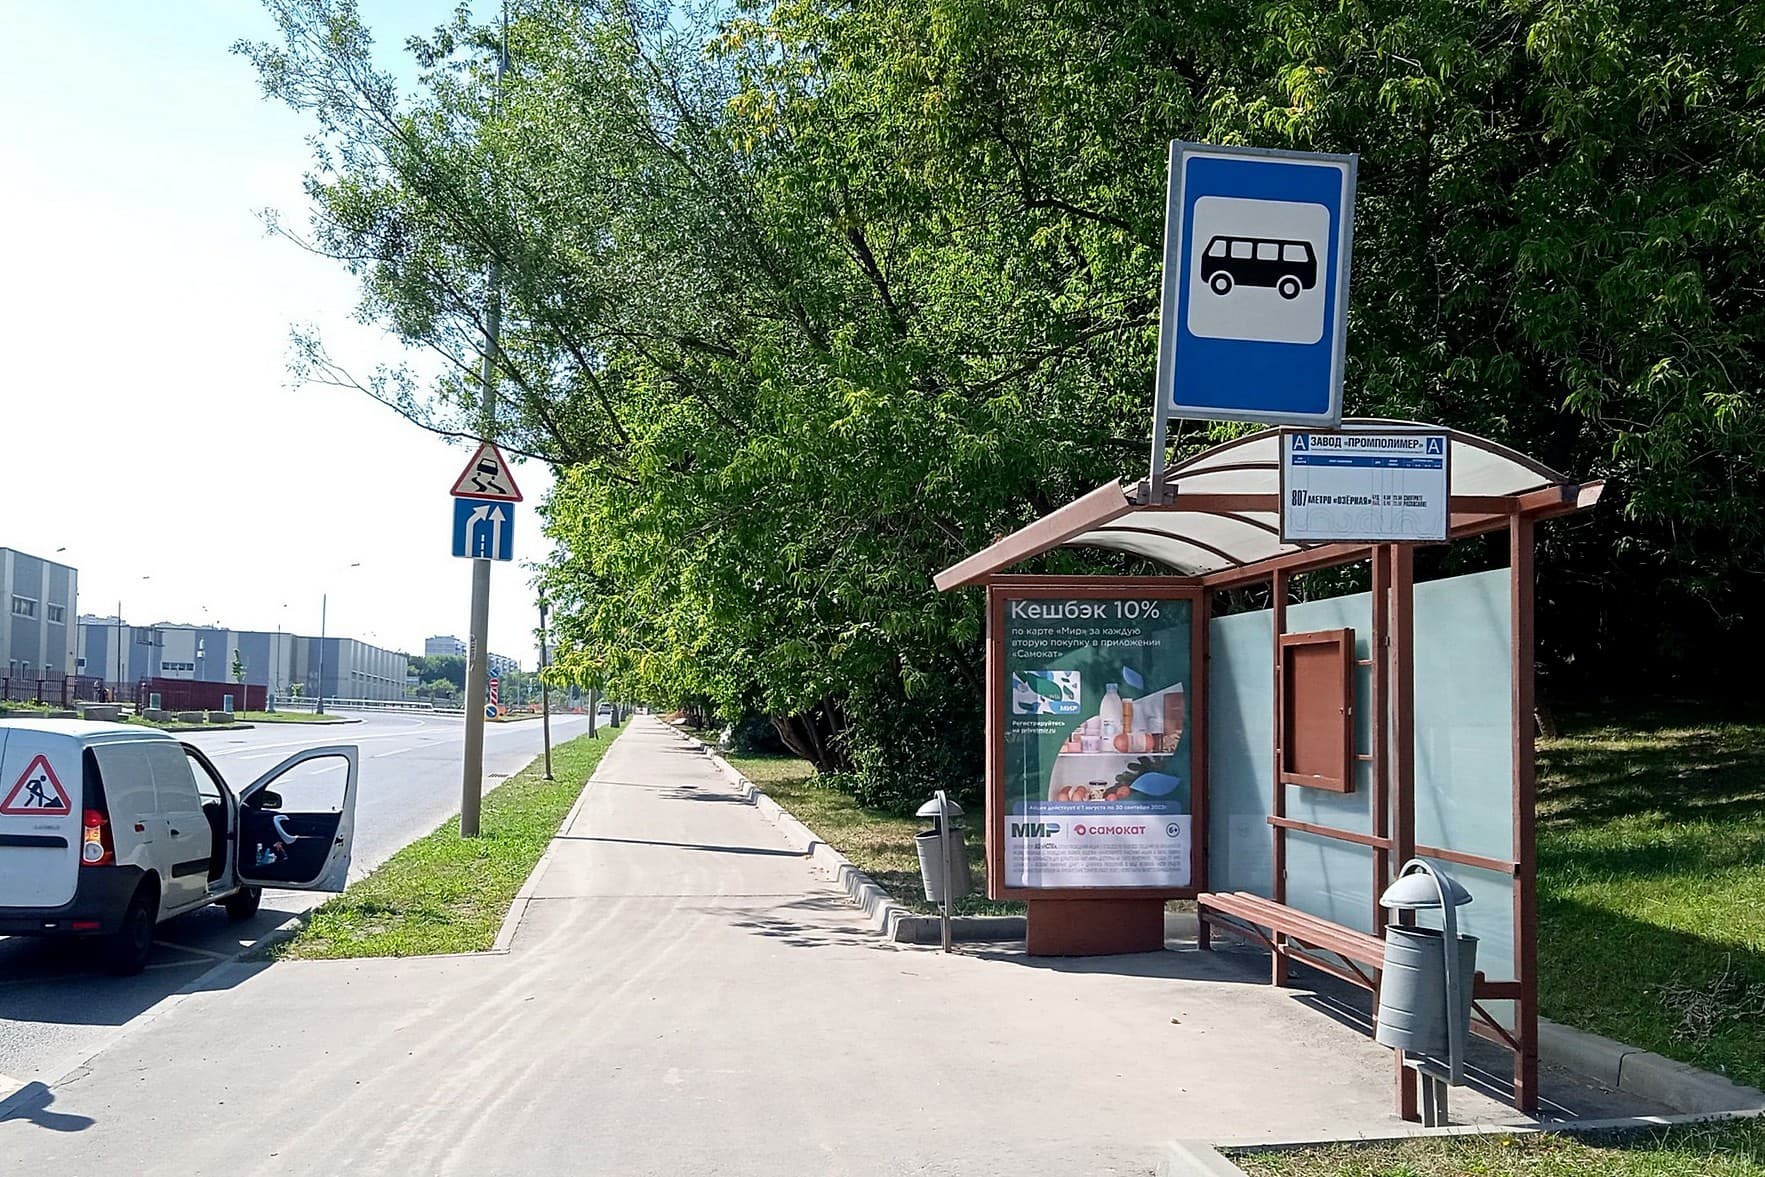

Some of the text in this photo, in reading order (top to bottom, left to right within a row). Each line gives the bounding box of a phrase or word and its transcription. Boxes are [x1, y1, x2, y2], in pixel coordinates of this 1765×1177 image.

[1310, 436, 1342, 448] ЗАВОД
[1343, 437, 1424, 449] «ПРОМПОЛИМЕР»
[1291, 489, 1308, 507] 807
[1308, 495, 1332, 504] МЕТРО
[1011, 600, 1160, 619] Кешбэк 10%
[1026, 628, 1054, 636] карте
[1056, 627, 1087, 636] «Мир»
[1102, 628, 1141, 636] каждую
[1011, 639, 1160, 648] вторую покупку в приложении
[1012, 649, 1063, 658] «Самокат»
[1011, 822, 1060, 838] МИР
[1089, 826, 1146, 835] самокат
